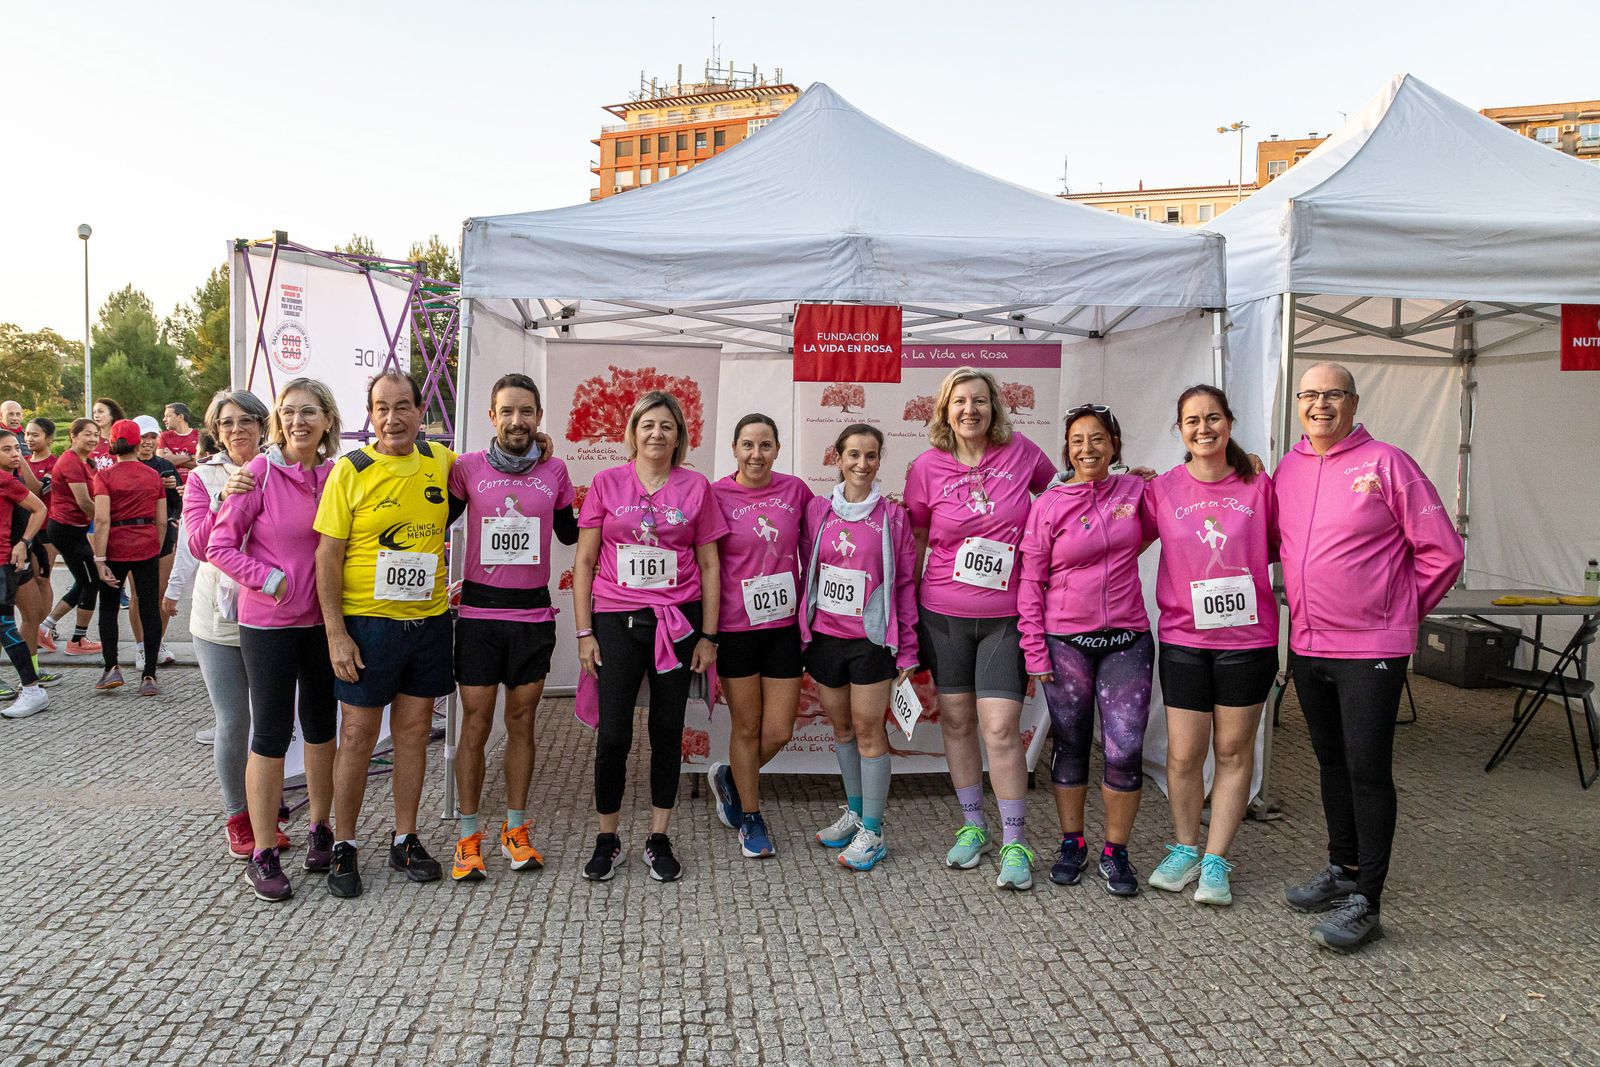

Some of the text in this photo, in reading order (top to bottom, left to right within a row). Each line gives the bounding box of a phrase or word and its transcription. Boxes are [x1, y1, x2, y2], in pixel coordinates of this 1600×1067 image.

[818, 332, 879, 341] FUNDACIÓN
[803, 344, 893, 353] LA VIDA EN ROSA
[912, 349, 925, 359] La
[930, 348, 956, 359] Vida
[980, 349, 1008, 360] Rosa
[477, 479, 511, 493] Corre
[525, 477, 554, 498] Rosa
[732, 503, 757, 520] Corre
[1175, 501, 1207, 519] Corre
[1221, 497, 1254, 517] Rosa
[407, 523, 435, 532] CLÍNICA
[492, 533, 529, 550] 0902
[629, 559, 665, 576] 1161
[965, 552, 1002, 574] 0654
[387, 567, 426, 587] 0828
[754, 589, 787, 610] 0216
[824, 580, 854, 602] 0903
[1204, 593, 1245, 614] 0650
[1110, 630, 1136, 646] MAX
[895, 690, 912, 724] 1032
